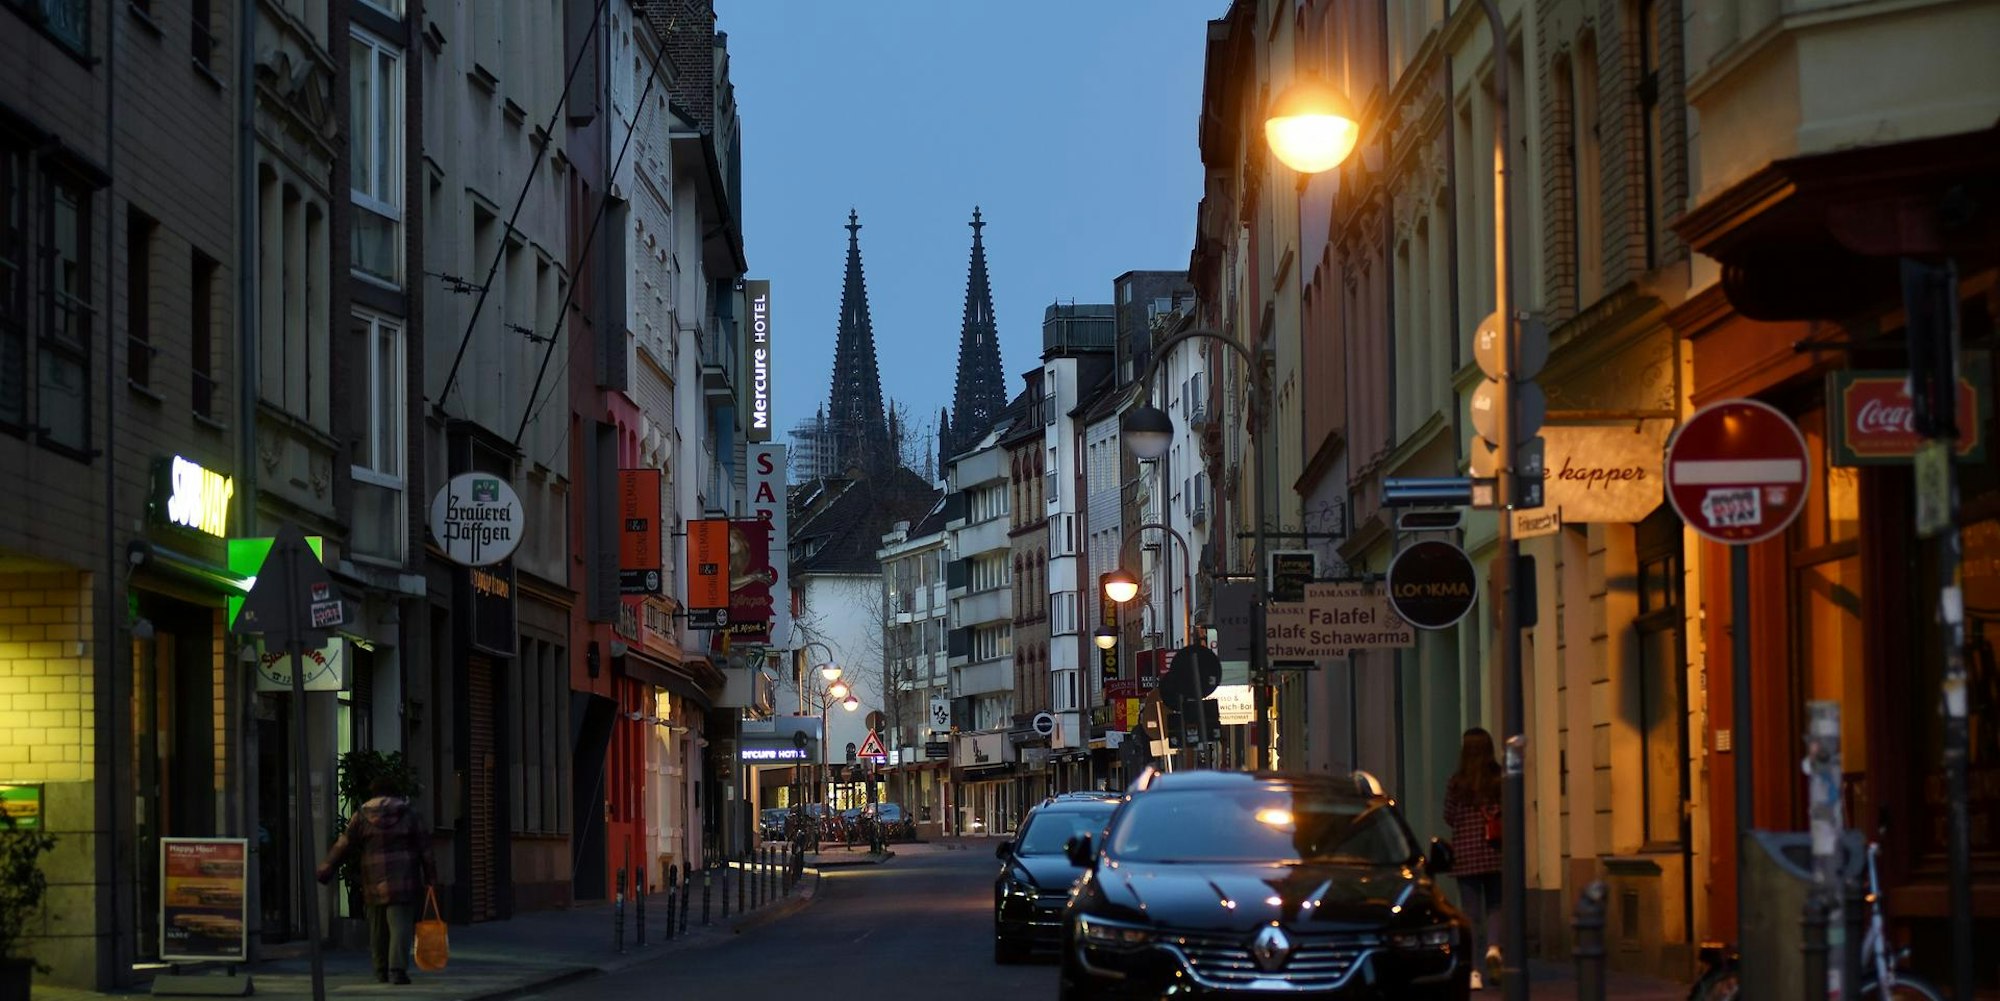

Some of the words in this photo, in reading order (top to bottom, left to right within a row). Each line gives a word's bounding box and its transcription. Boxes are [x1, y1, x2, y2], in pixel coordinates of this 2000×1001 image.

[754, 294, 767, 343] HOTEL
[753, 348, 768, 430] Mercure
[1558, 455, 1647, 490] kapper
[1308, 607, 1376, 625] Falafel
[1267, 623, 1305, 639] alafe
[1309, 630, 1410, 645] Schawarma
[741, 750, 776, 759] ercure
